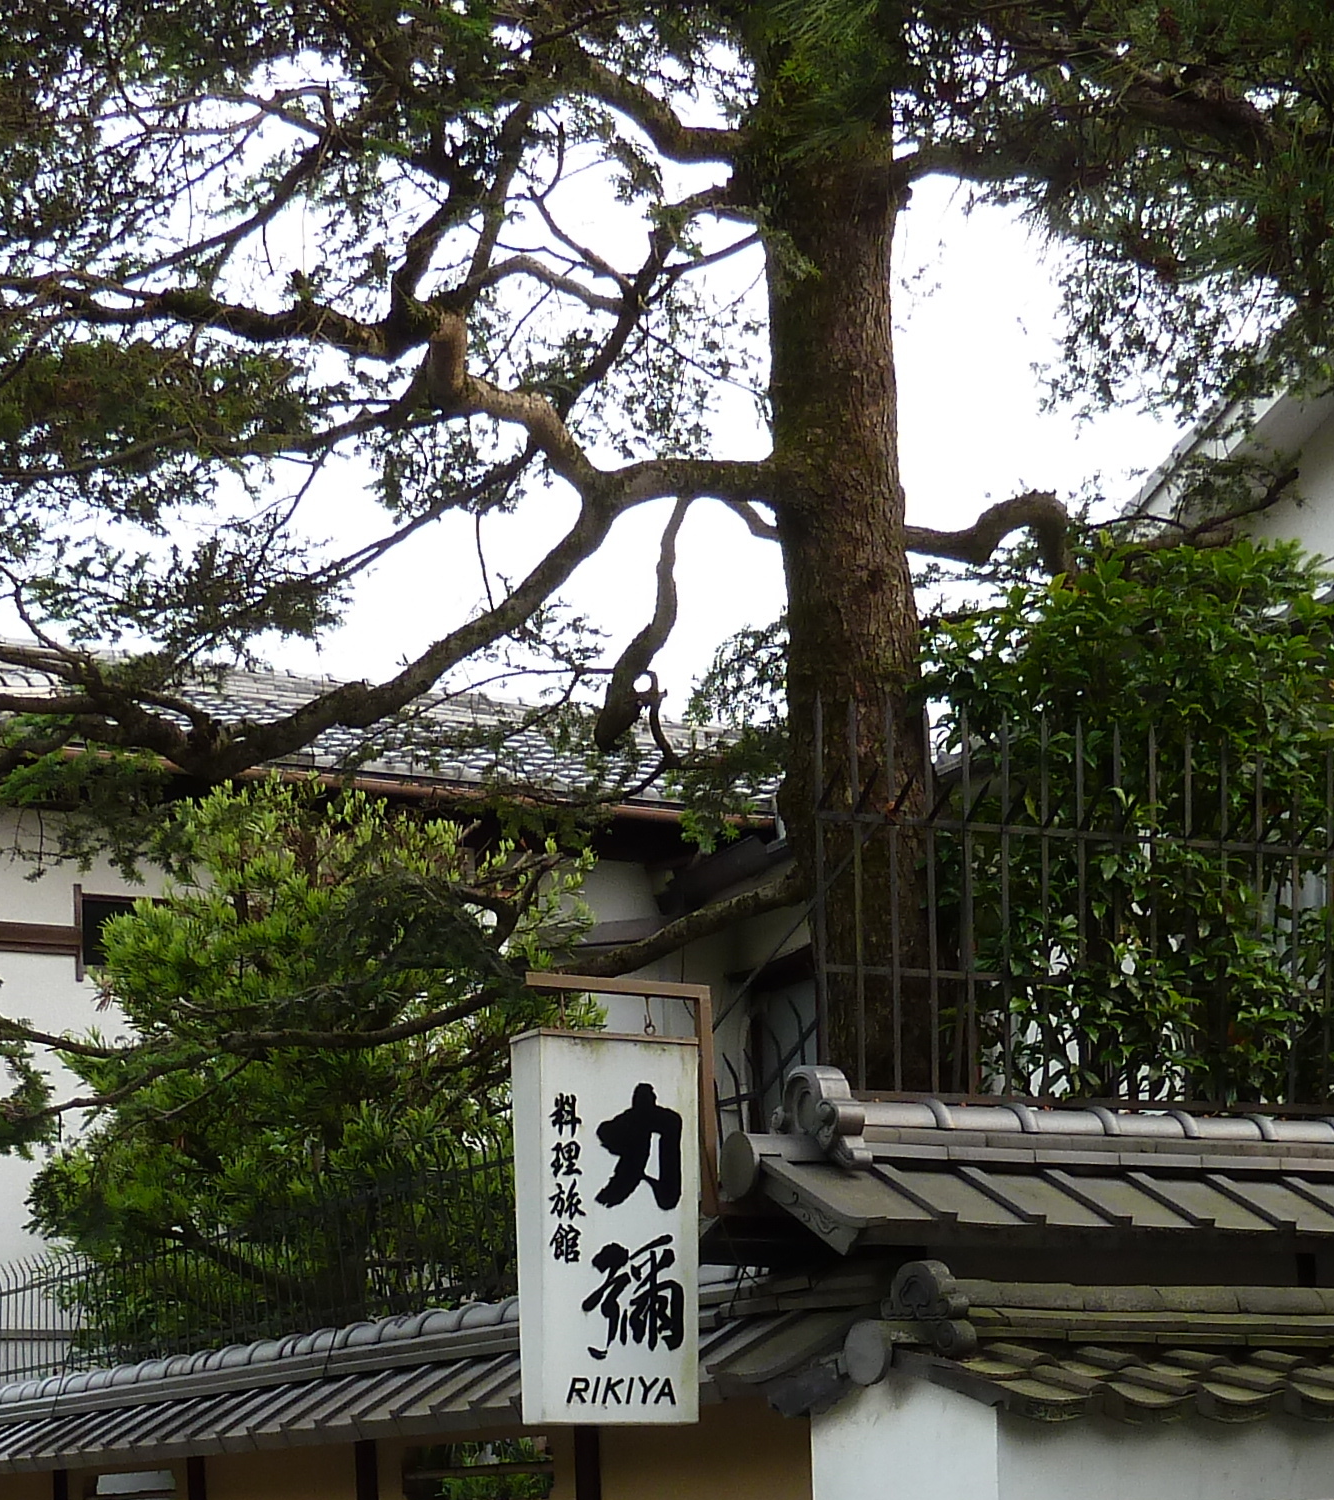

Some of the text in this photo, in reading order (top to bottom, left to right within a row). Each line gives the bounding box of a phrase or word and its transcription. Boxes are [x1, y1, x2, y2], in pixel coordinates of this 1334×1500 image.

[549, 1093, 586, 1264] 料理旅館
[566, 1376, 677, 1406] RIKIYA
